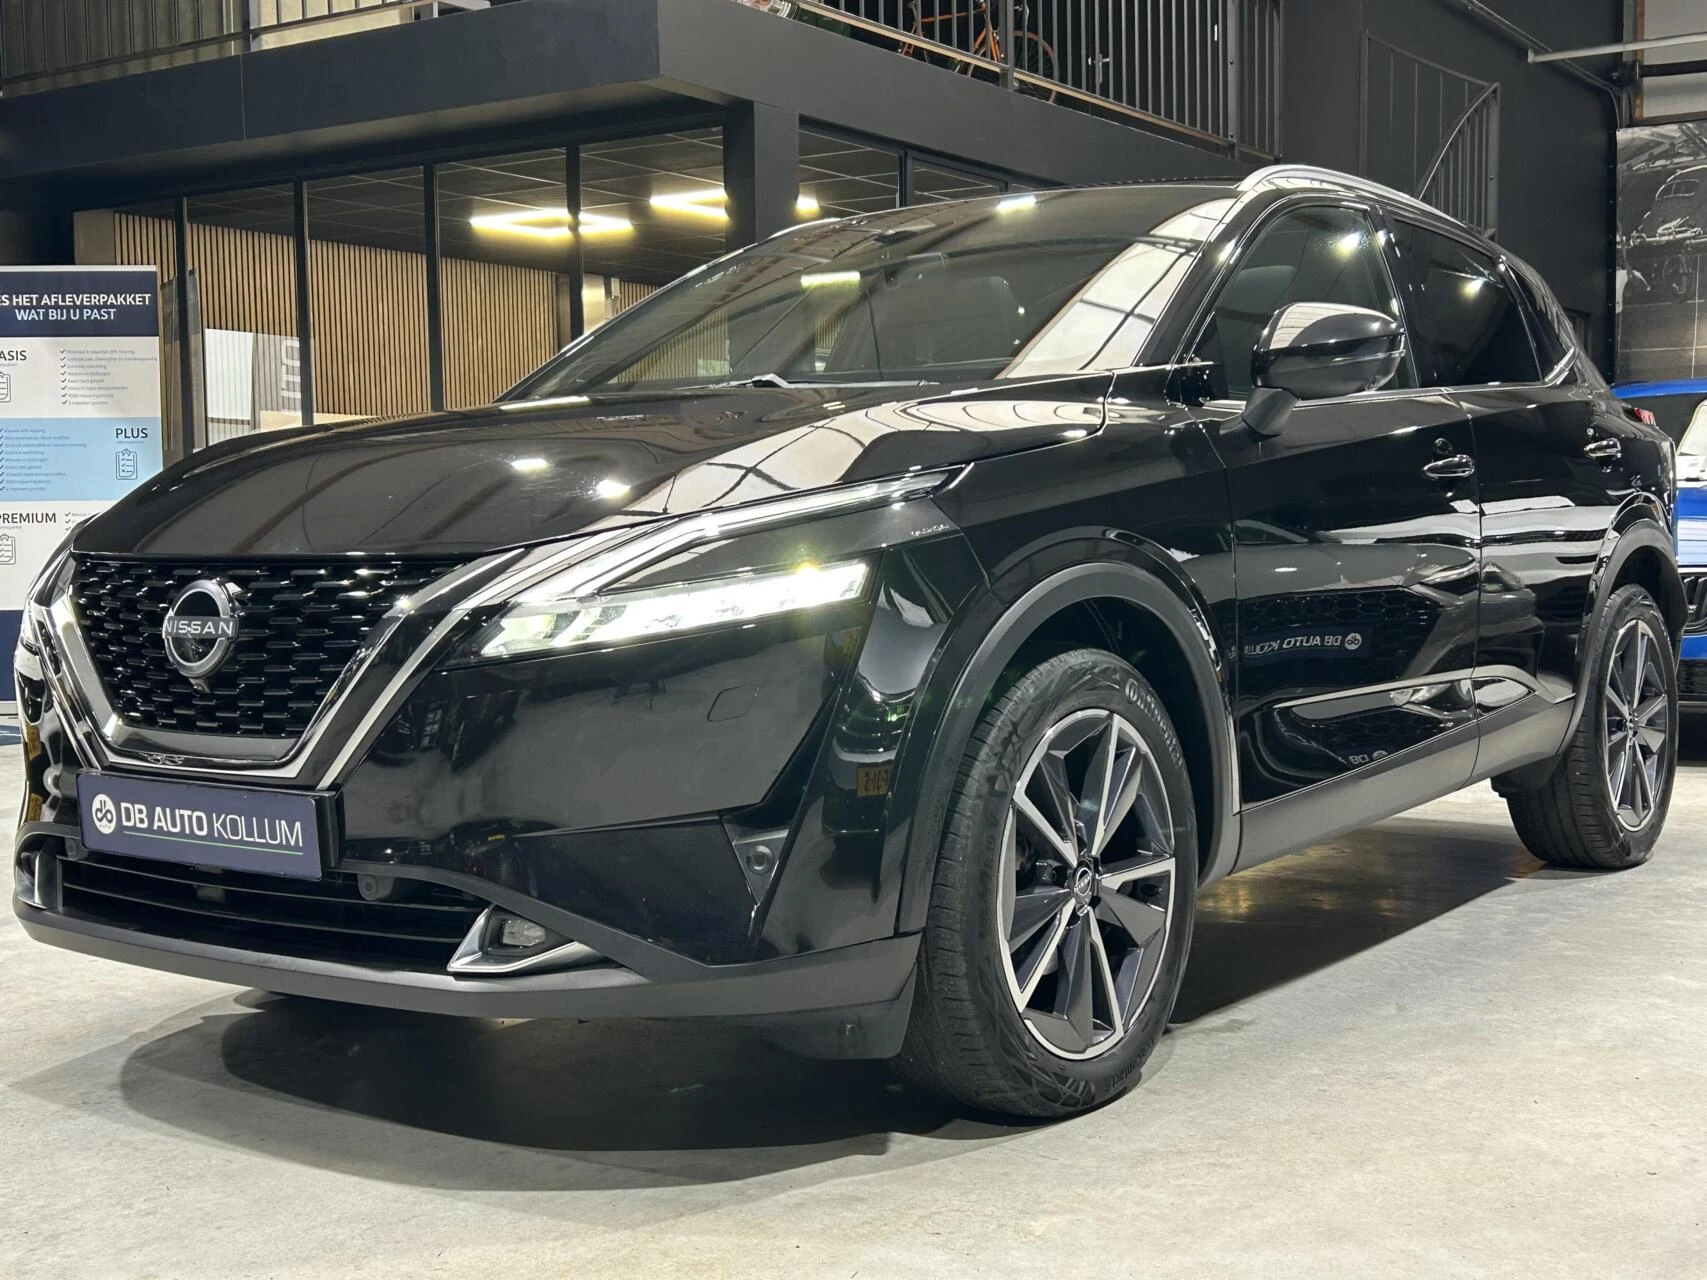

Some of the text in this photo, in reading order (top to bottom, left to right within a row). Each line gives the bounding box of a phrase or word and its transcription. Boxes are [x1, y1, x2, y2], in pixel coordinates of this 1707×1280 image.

[0, 293, 152, 306] S HET AFLEVERPAKKET
[15, 308, 117, 321] WAT BIJ U PAST
[115, 427, 149, 439] PLUS
[0, 512, 57, 524] REMIUM
[165, 620, 233, 637] NISSAN
[120, 802, 303, 847] DB AUTO KOLLUM
